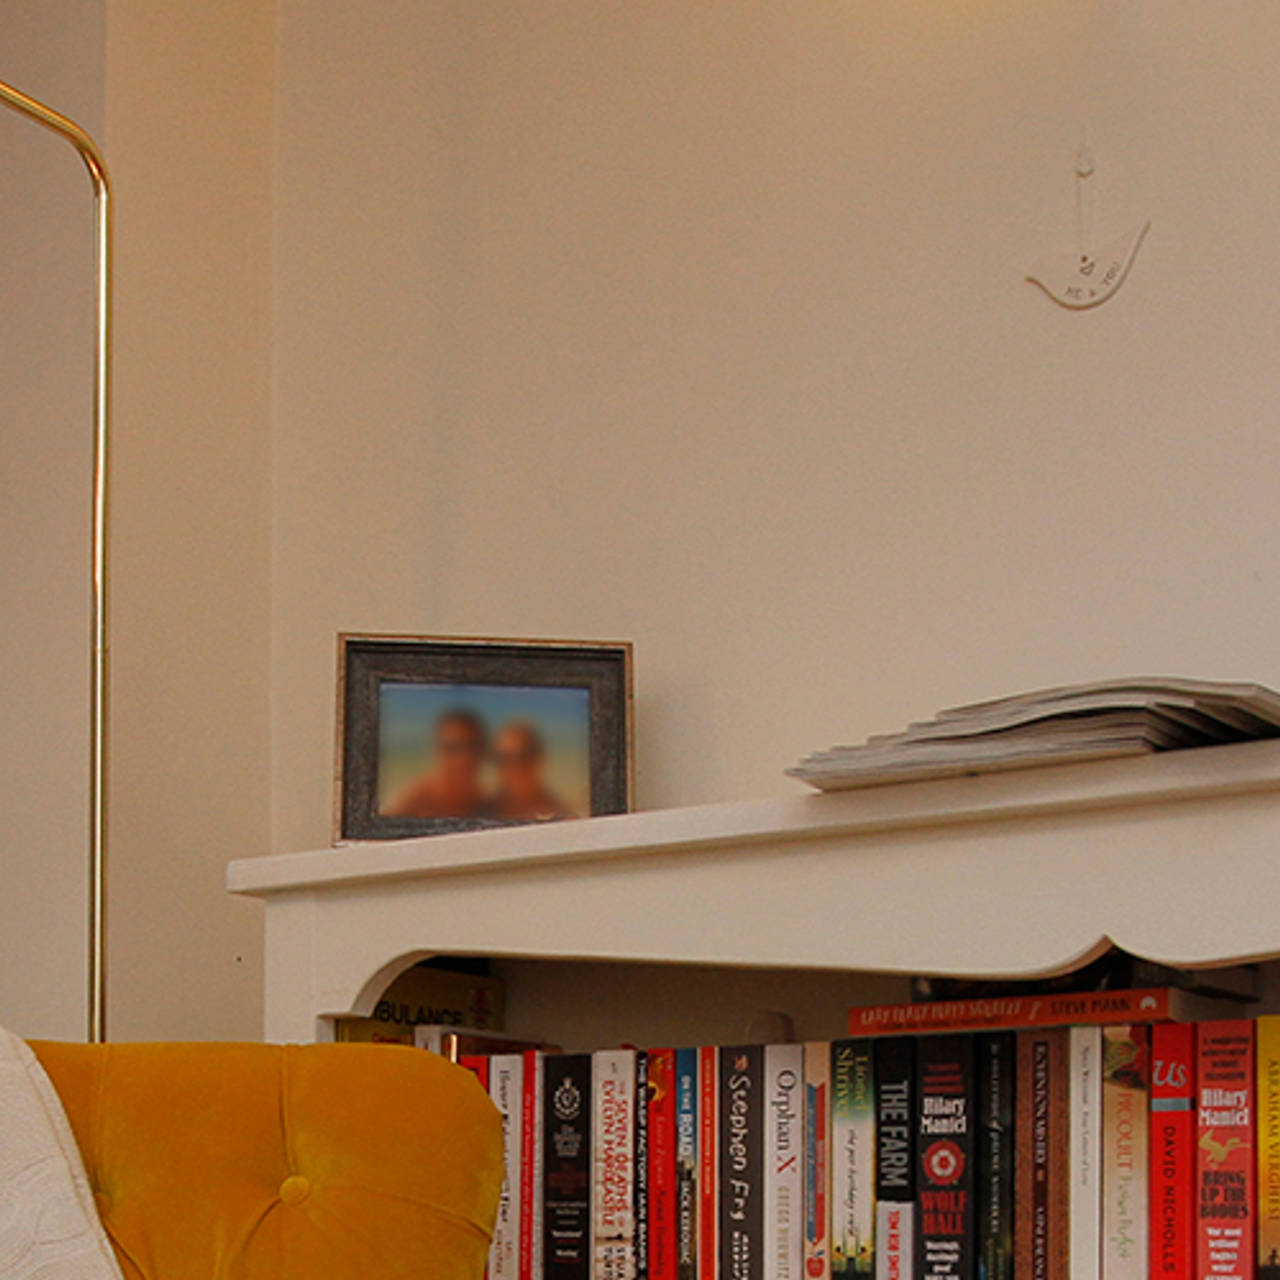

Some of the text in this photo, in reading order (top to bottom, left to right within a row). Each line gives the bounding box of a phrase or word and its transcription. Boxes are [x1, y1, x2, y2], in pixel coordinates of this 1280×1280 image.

[922, 1097, 966, 1116] Hilary
[1201, 1088, 1248, 1108] Hilary
[1267, 1058, 1280, 1138] ABRAHAM
[771, 1069, 798, 1175] Orphan X
[921, 1117, 967, 1134] Mantel
[1198, 1108, 1249, 1127] Mantel
[880, 1081, 909, 1188] THE FARM
[603, 1080, 615, 1227] EVELYN HARDCASTLE
[616, 1099, 629, 1214] SEVEN DEATHS
[729, 1075, 751, 1221] Stephen Fry
[921, 1190, 967, 1212] WOLF
[1163, 1125, 1176, 1273] DAVID NICHOLLS
[887, 1209, 901, 1230] TOM
[923, 1213, 965, 1236] HALL
[887, 1233, 901, 1250] ROB
